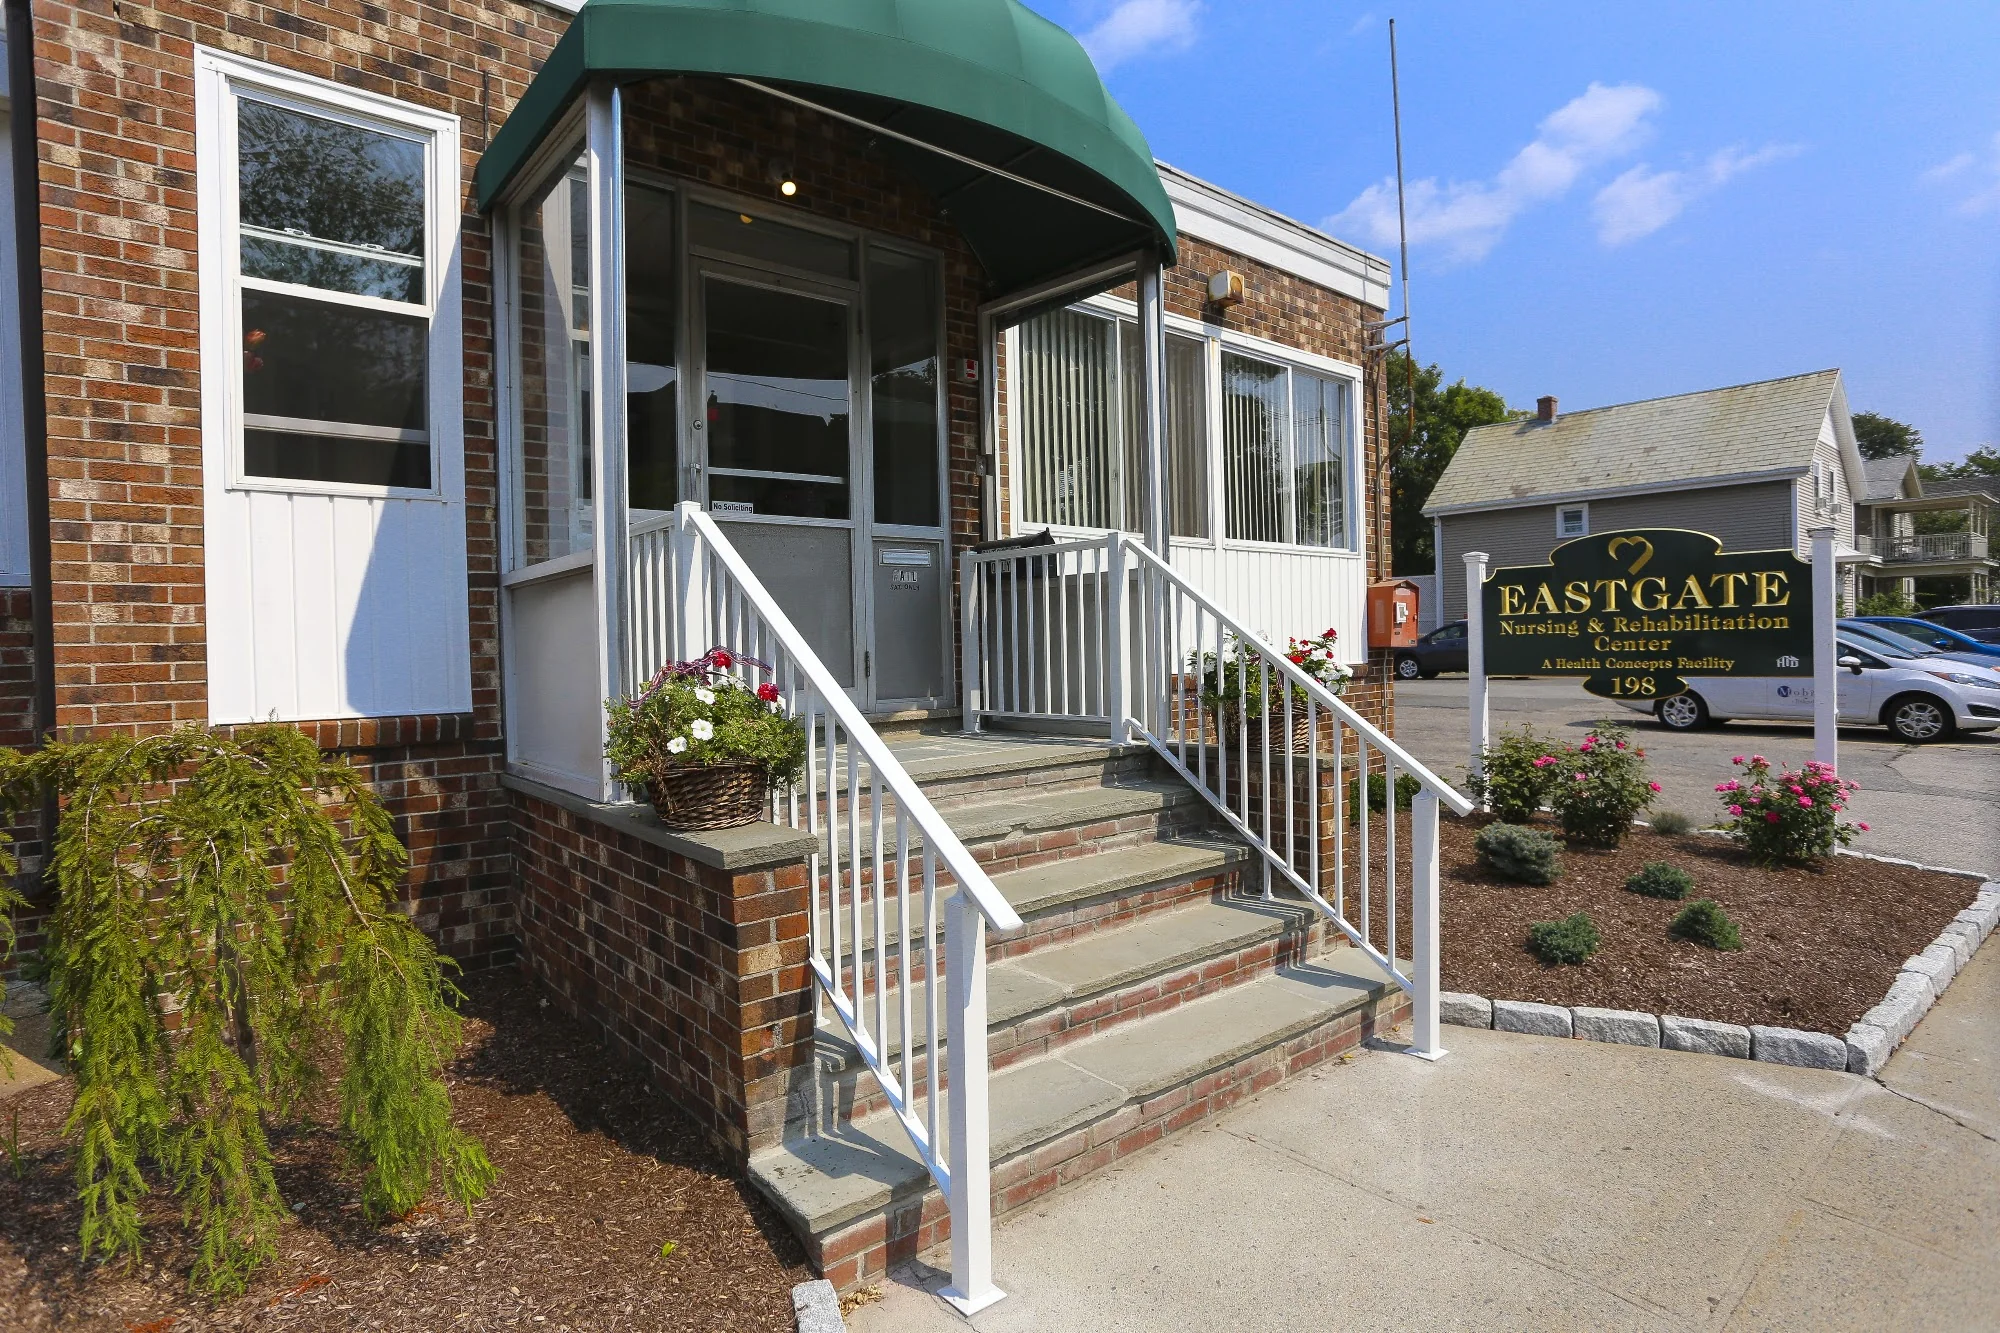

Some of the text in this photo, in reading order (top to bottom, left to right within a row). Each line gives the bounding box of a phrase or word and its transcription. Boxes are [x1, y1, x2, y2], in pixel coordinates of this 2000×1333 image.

[724, 504, 753, 514] Soliciting
[1498, 571, 1790, 616] EASTGATE
[1500, 613, 1790, 637] Nursing & Rehabilitation
[1594, 636, 1672, 652] Center
[1541, 657, 1735, 672] A Health Concepts Facility
[1611, 676, 1656, 695] 198
